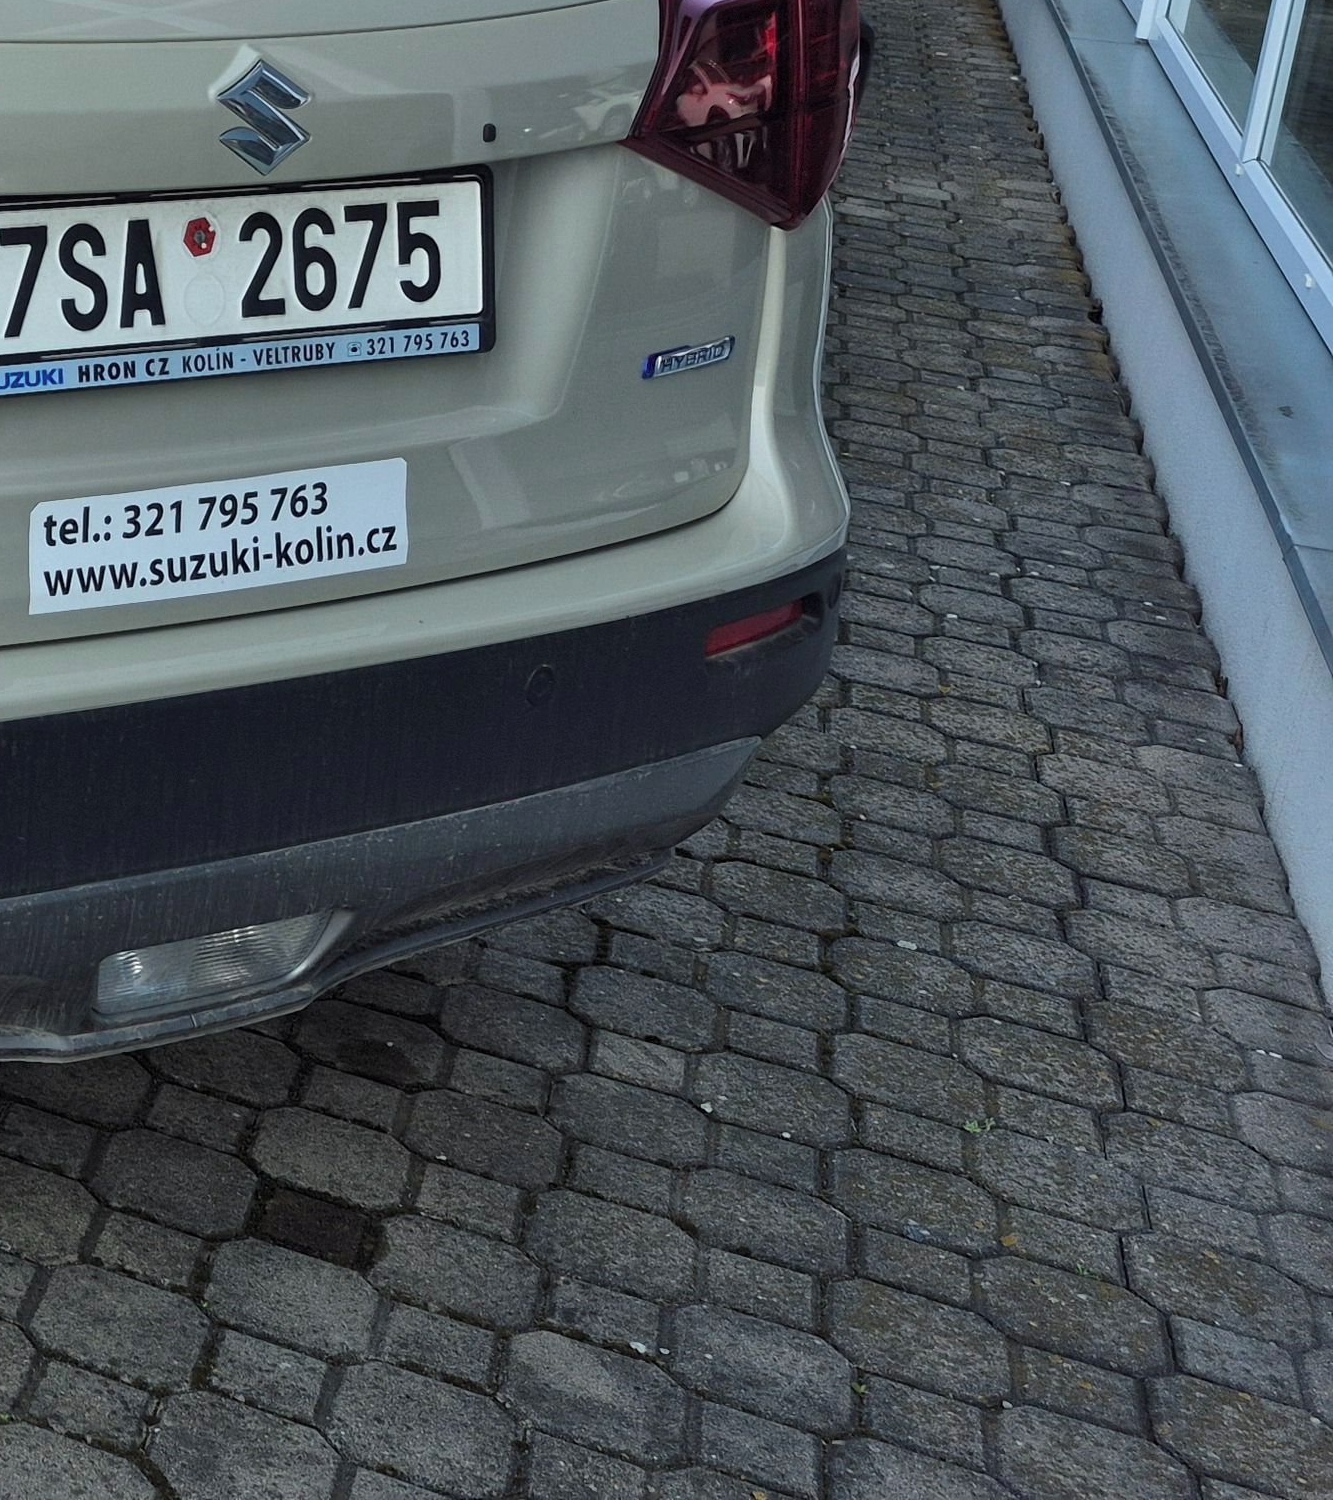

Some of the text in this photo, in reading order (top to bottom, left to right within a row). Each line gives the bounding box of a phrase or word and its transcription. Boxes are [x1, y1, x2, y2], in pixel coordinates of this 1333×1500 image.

[238, 199, 443, 318] 2675
[78, 360, 136, 383] HRON
[145, 357, 170, 377] CZ
[182, 347, 234, 373] KOLÍN
[252, 342, 336, 366] VELTRUBY
[366, 336, 395, 356] 321
[403, 333, 433, 352] 795
[440, 329, 470, 348] 763
[661, 343, 725, 373] HYBRID
[43, 482, 328, 546] tel.: 321 795 763
[43, 525, 397, 597] www.suzuki-kolin.cz
